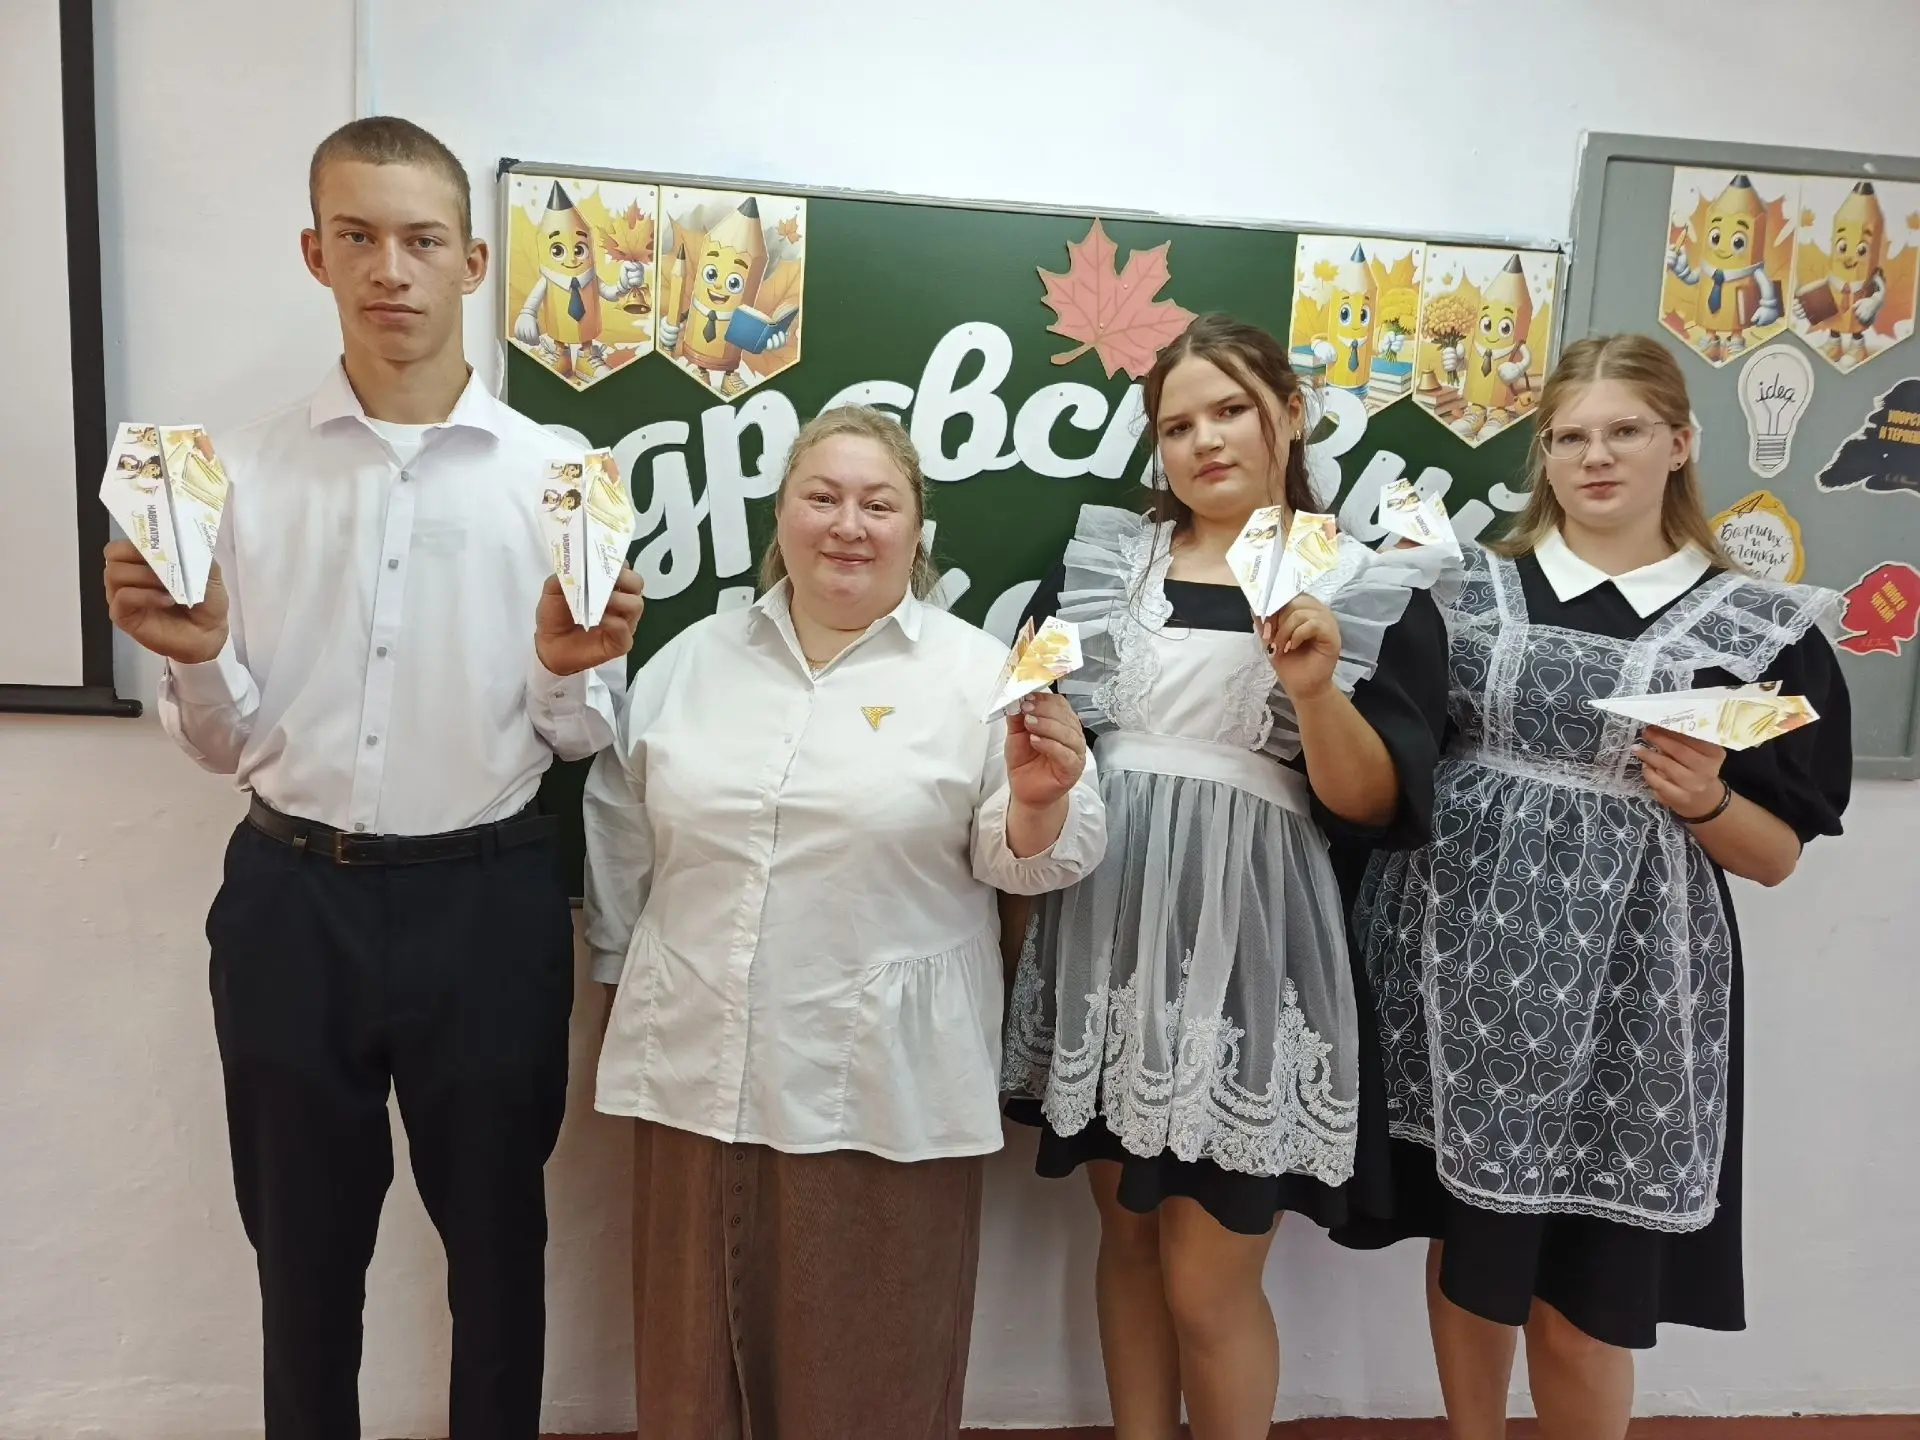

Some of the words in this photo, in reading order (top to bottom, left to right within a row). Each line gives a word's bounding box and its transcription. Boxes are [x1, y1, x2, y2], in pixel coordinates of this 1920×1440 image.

[1755, 372, 1796, 403] idea
[147, 504, 160, 550] НАВИГАТОРЫ
[562, 533, 571, 575] НАВИГАТОРЫ
